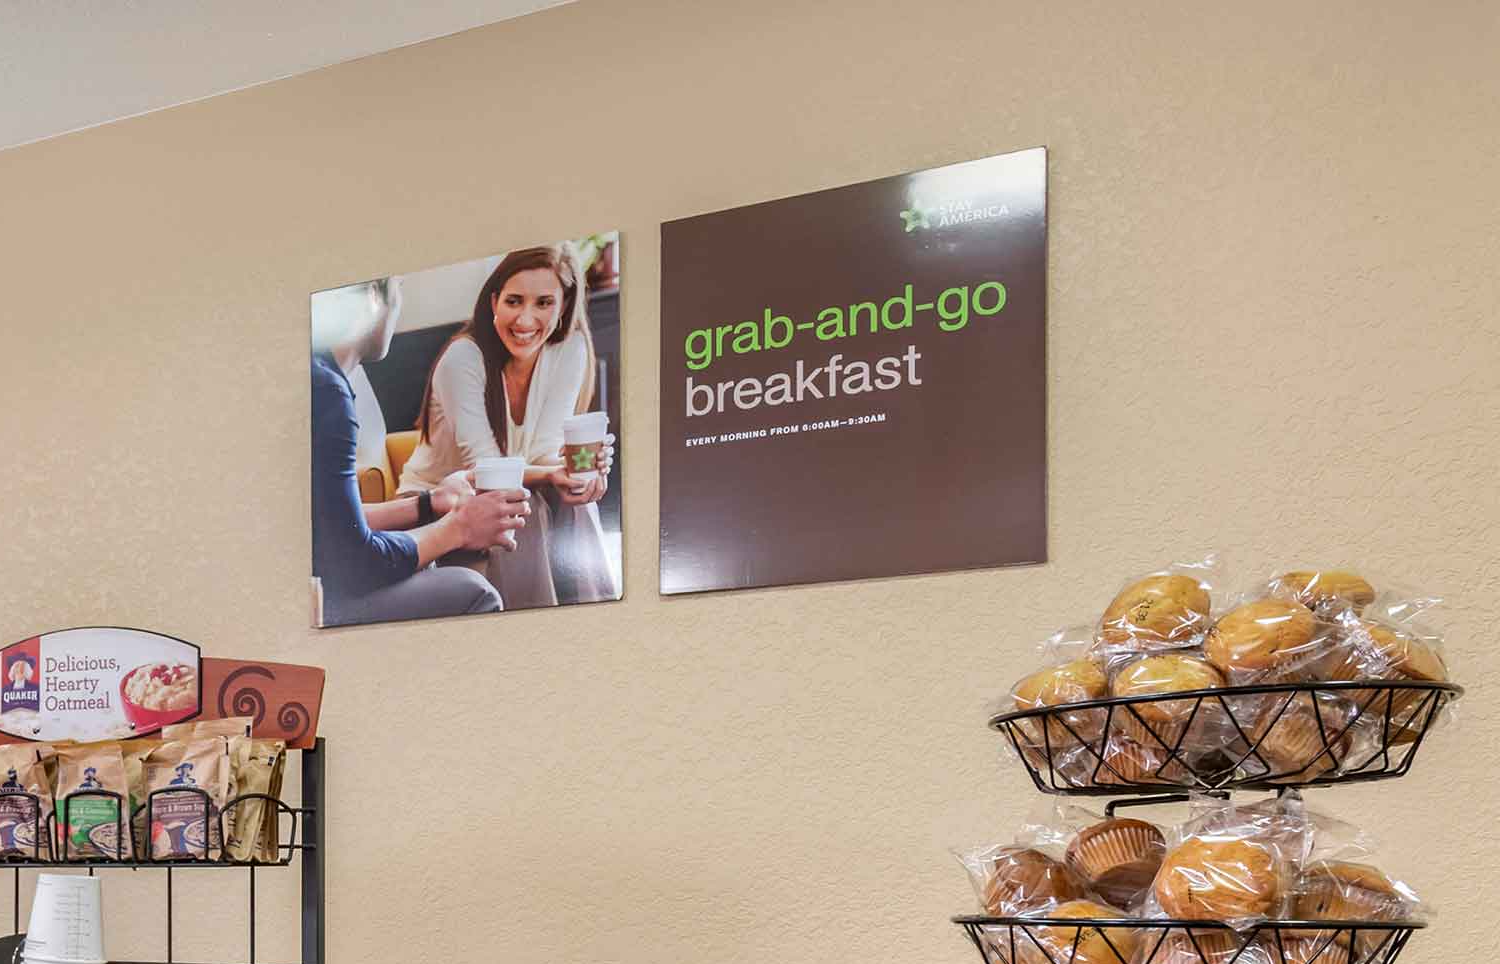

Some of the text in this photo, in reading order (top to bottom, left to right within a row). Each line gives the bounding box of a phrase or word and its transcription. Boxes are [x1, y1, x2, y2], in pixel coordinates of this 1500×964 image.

[939, 204, 1010, 227] AMERICA
[684, 281, 1007, 370] grab-and-go
[685, 345, 922, 417] breakfast
[686, 435, 717, 447] EVERY
[720, 429, 767, 443] MORNING
[770, 425, 799, 436] FROM
[45, 654, 120, 673] Delicious,
[45, 675, 100, 694] Hearty
[3, 690, 38, 703] QUAKER
[45, 691, 110, 711] Oatmeal
